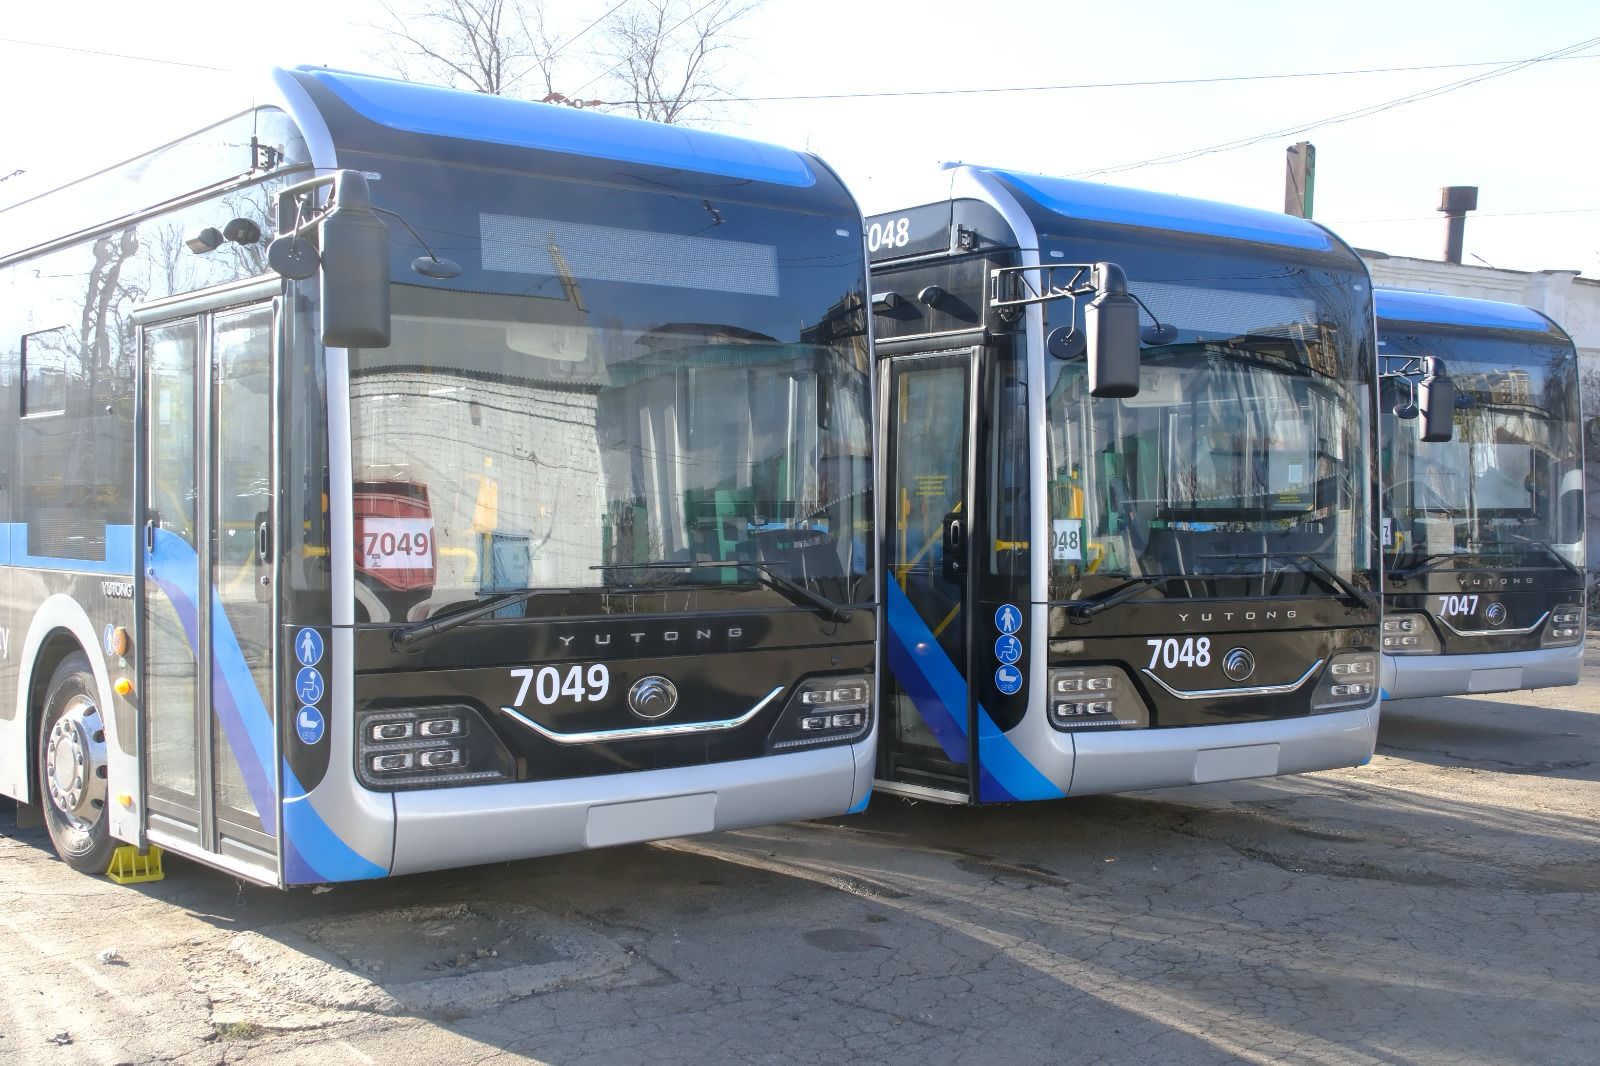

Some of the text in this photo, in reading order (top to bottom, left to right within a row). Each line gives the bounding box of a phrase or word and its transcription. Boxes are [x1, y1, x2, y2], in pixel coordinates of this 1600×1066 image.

[866, 217, 909, 252] 048
[364, 532, 428, 556] 7049
[1053, 531, 1078, 549] 048
[1179, 610, 1297, 622] YUTONG
[1439, 594, 1479, 616] 7047
[560, 628, 743, 646] YUTONG
[1147, 637, 1211, 670] 7048
[510, 664, 610, 707] 7049
